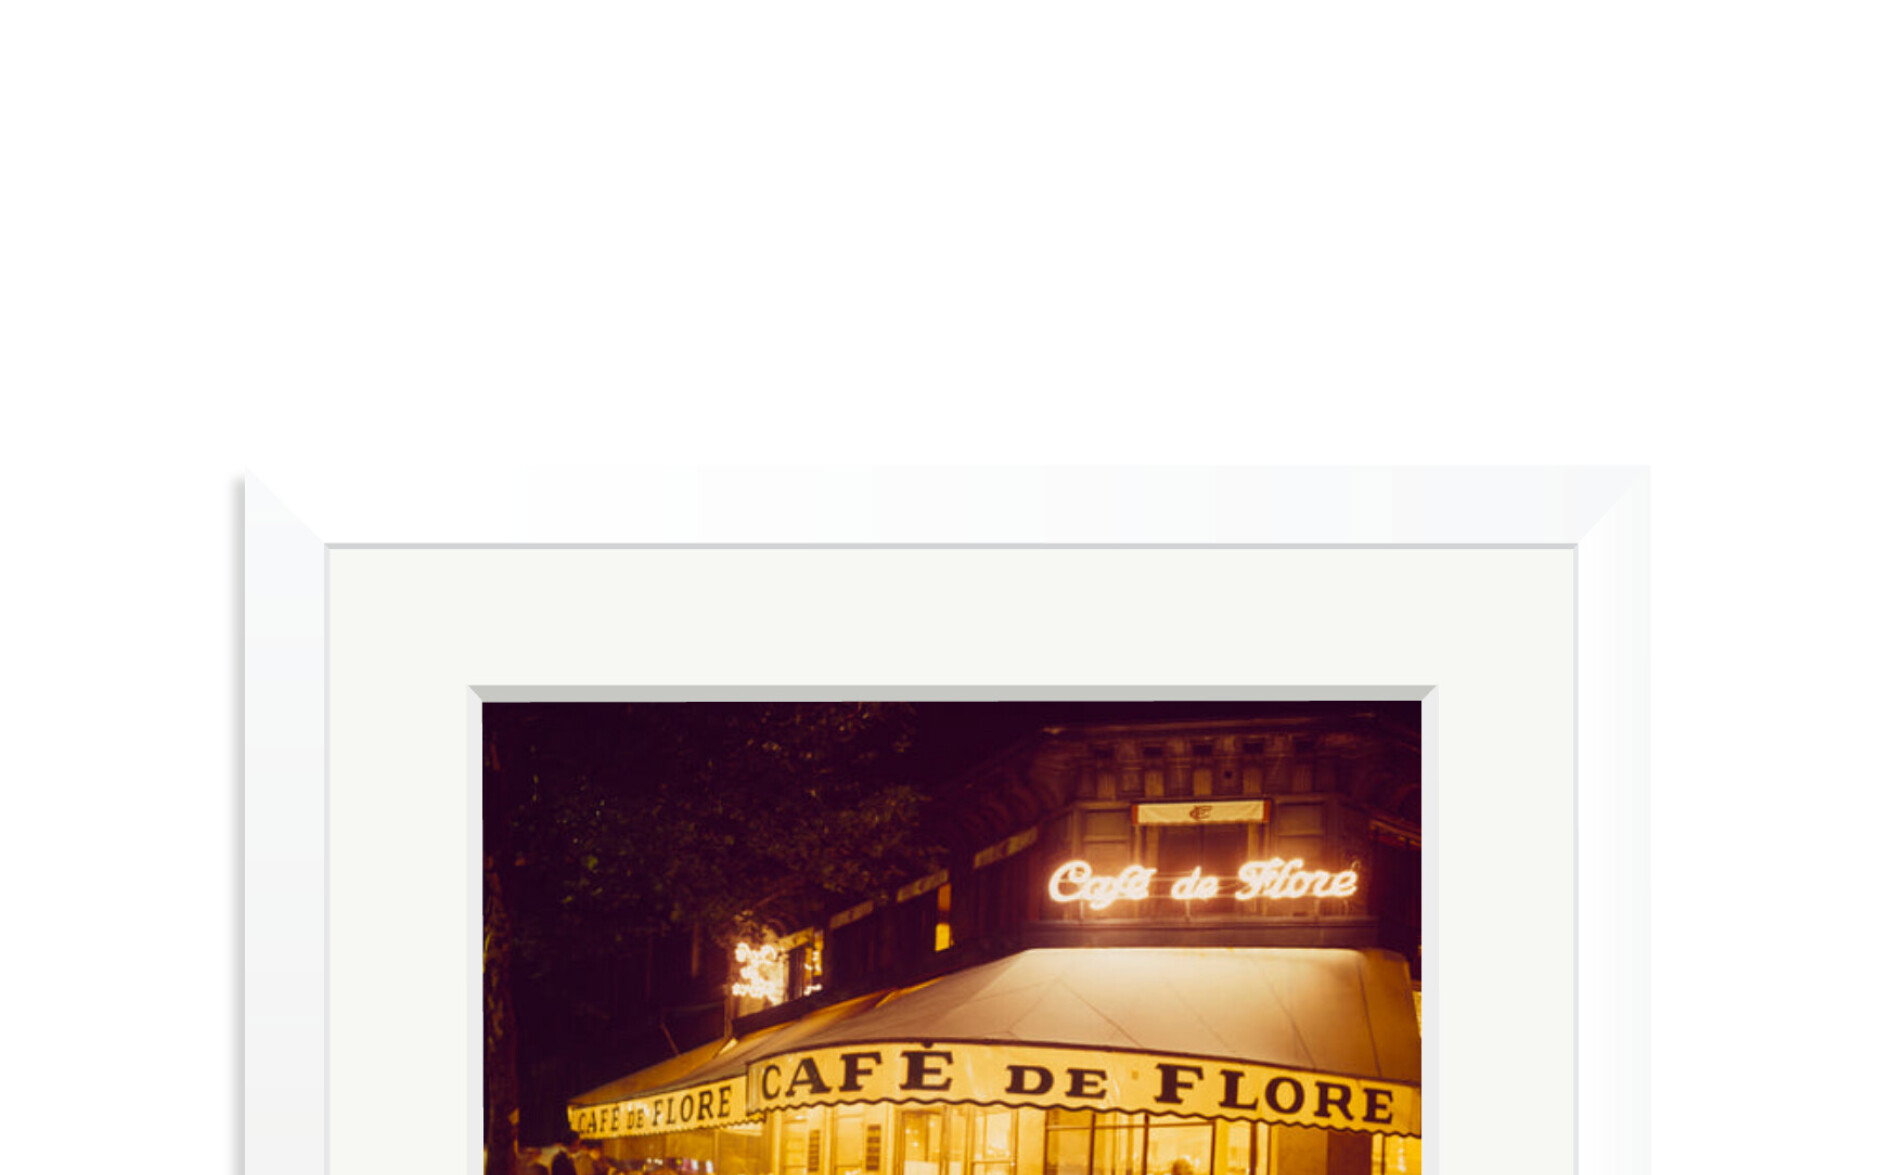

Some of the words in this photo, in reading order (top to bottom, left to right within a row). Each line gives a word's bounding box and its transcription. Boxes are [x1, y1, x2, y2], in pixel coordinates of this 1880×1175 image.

[1171, 866, 1219, 900] de
[1234, 858, 1358, 900] Flore
[627, 1108, 644, 1130] DE
[652, 1085, 732, 1127] FLORE
[1005, 1064, 1107, 1099] DE
[1154, 1063, 1395, 1125] FLORE
